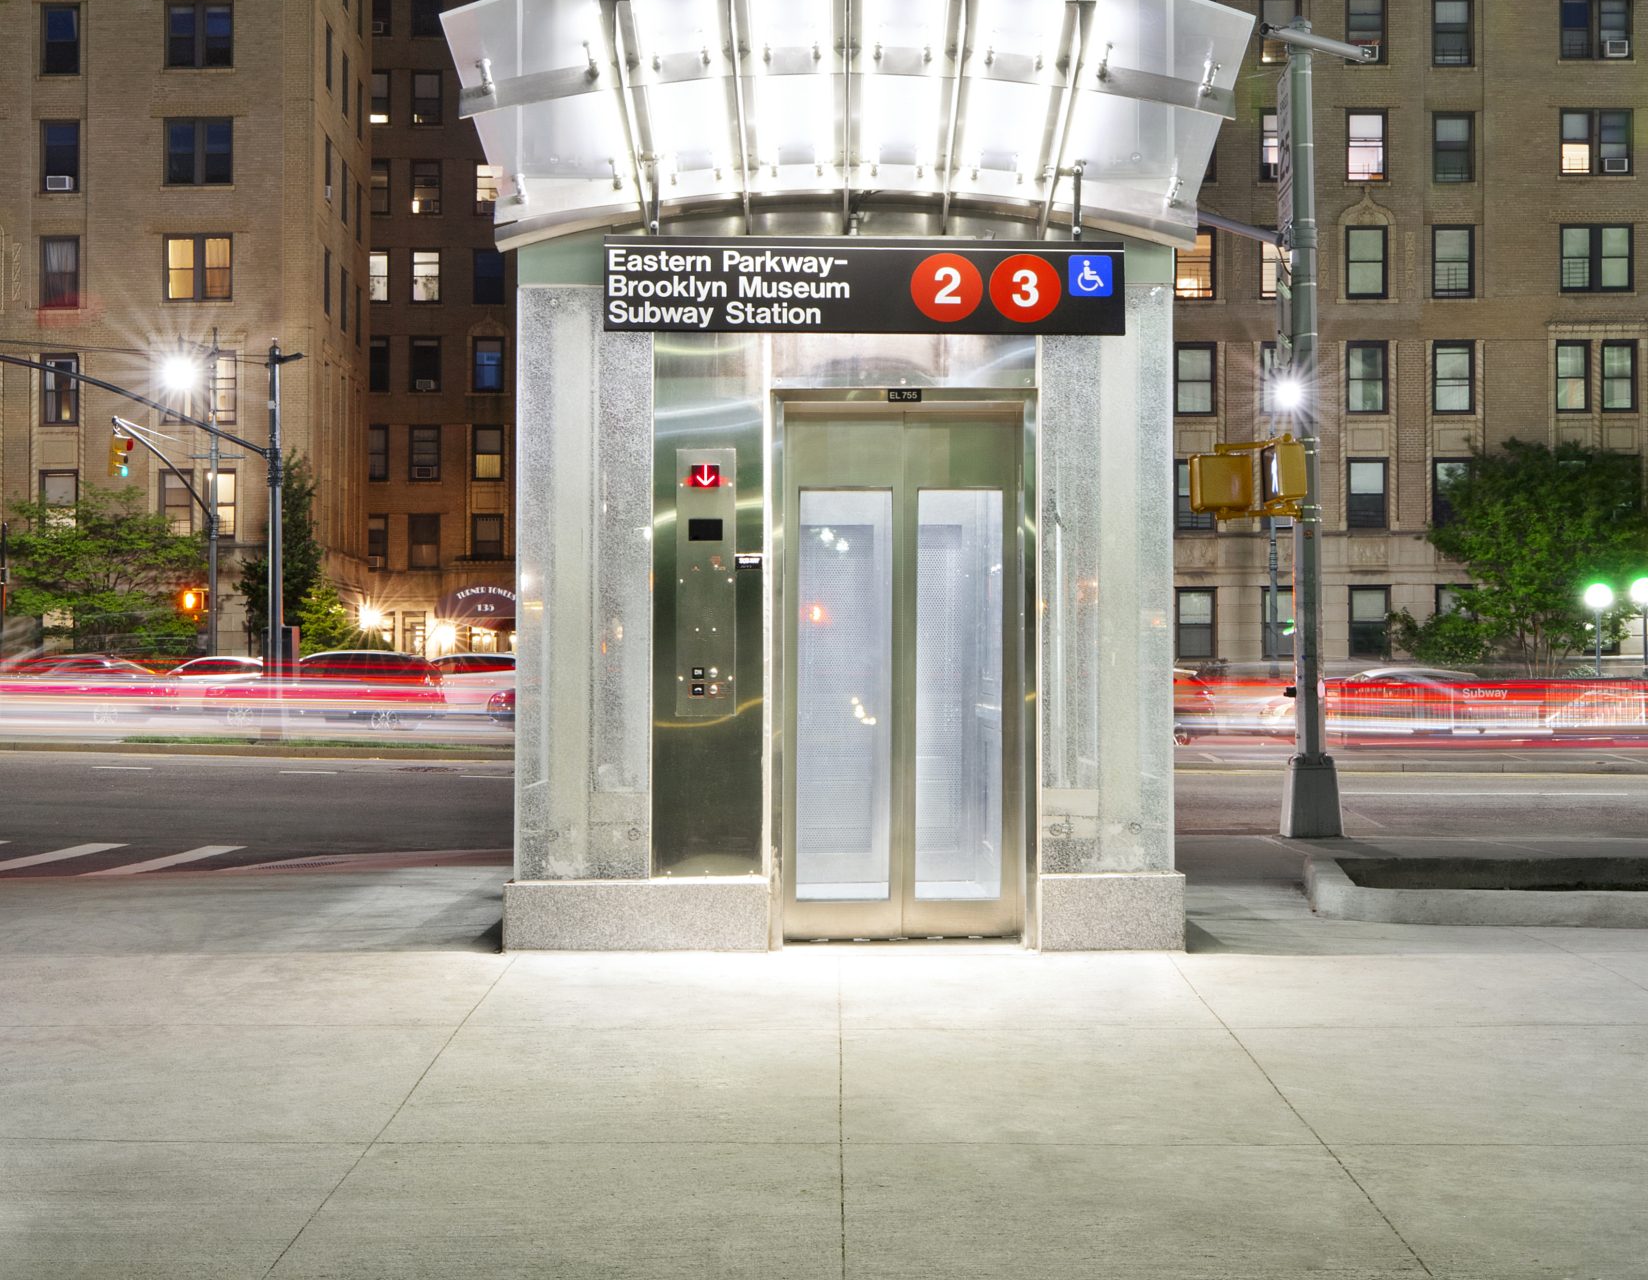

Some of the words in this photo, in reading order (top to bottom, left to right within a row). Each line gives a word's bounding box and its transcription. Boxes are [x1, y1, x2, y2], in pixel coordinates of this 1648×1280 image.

[1279, 130, 1291, 183] 25
[608, 249, 712, 272] Eastern
[722, 250, 848, 278] Parkway-
[608, 274, 728, 302] Brooklyn
[738, 275, 850, 299] Museum
[934, 266, 962, 305] 2
[1011, 269, 1040, 308] 3
[608, 300, 714, 328] Subway
[725, 301, 822, 325] Station
[889, 391, 901, 400] EL
[901, 391, 918, 400] 755
[456, 586, 487, 600] TURNER
[476, 603, 495, 612] 135
[1462, 687, 1508, 700] Subway
